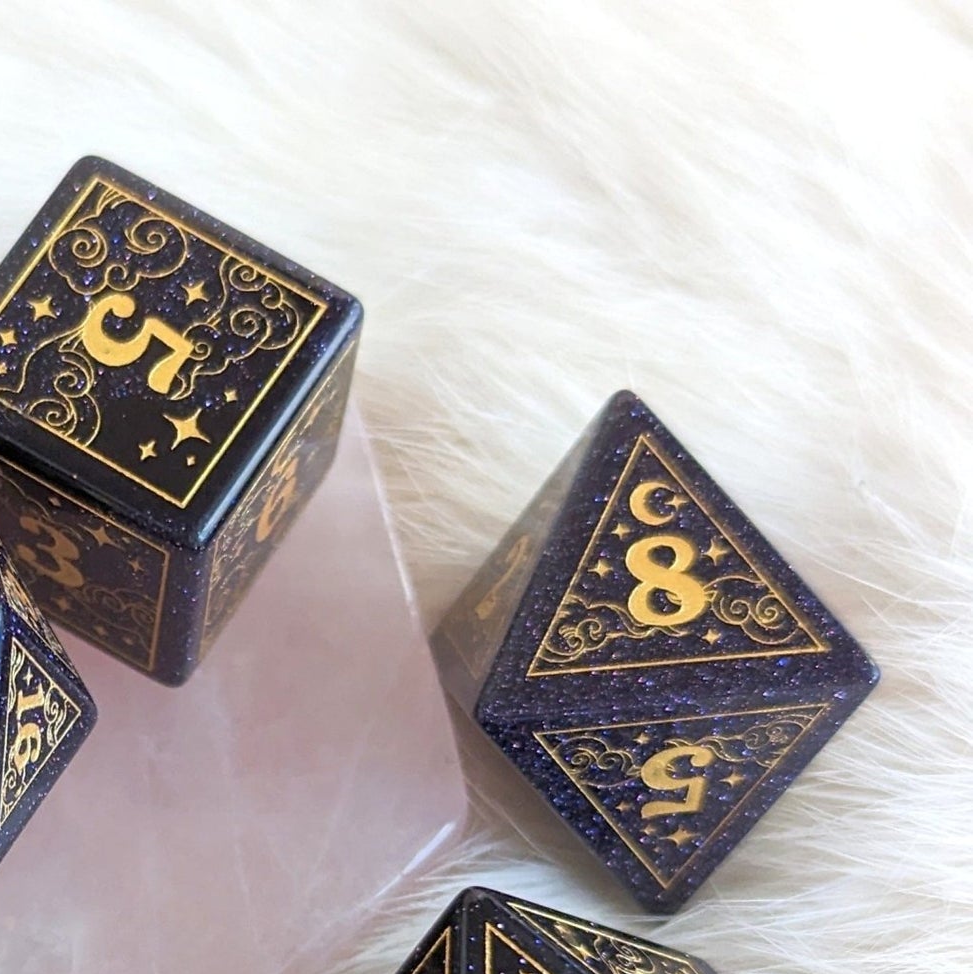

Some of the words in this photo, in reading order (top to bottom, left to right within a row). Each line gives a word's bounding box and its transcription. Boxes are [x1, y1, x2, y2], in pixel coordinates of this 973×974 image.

[83, 294, 197, 394] 5
[17, 516, 84, 588] 3
[626, 535, 708, 626] 8
[640, 745, 715, 820] 5
